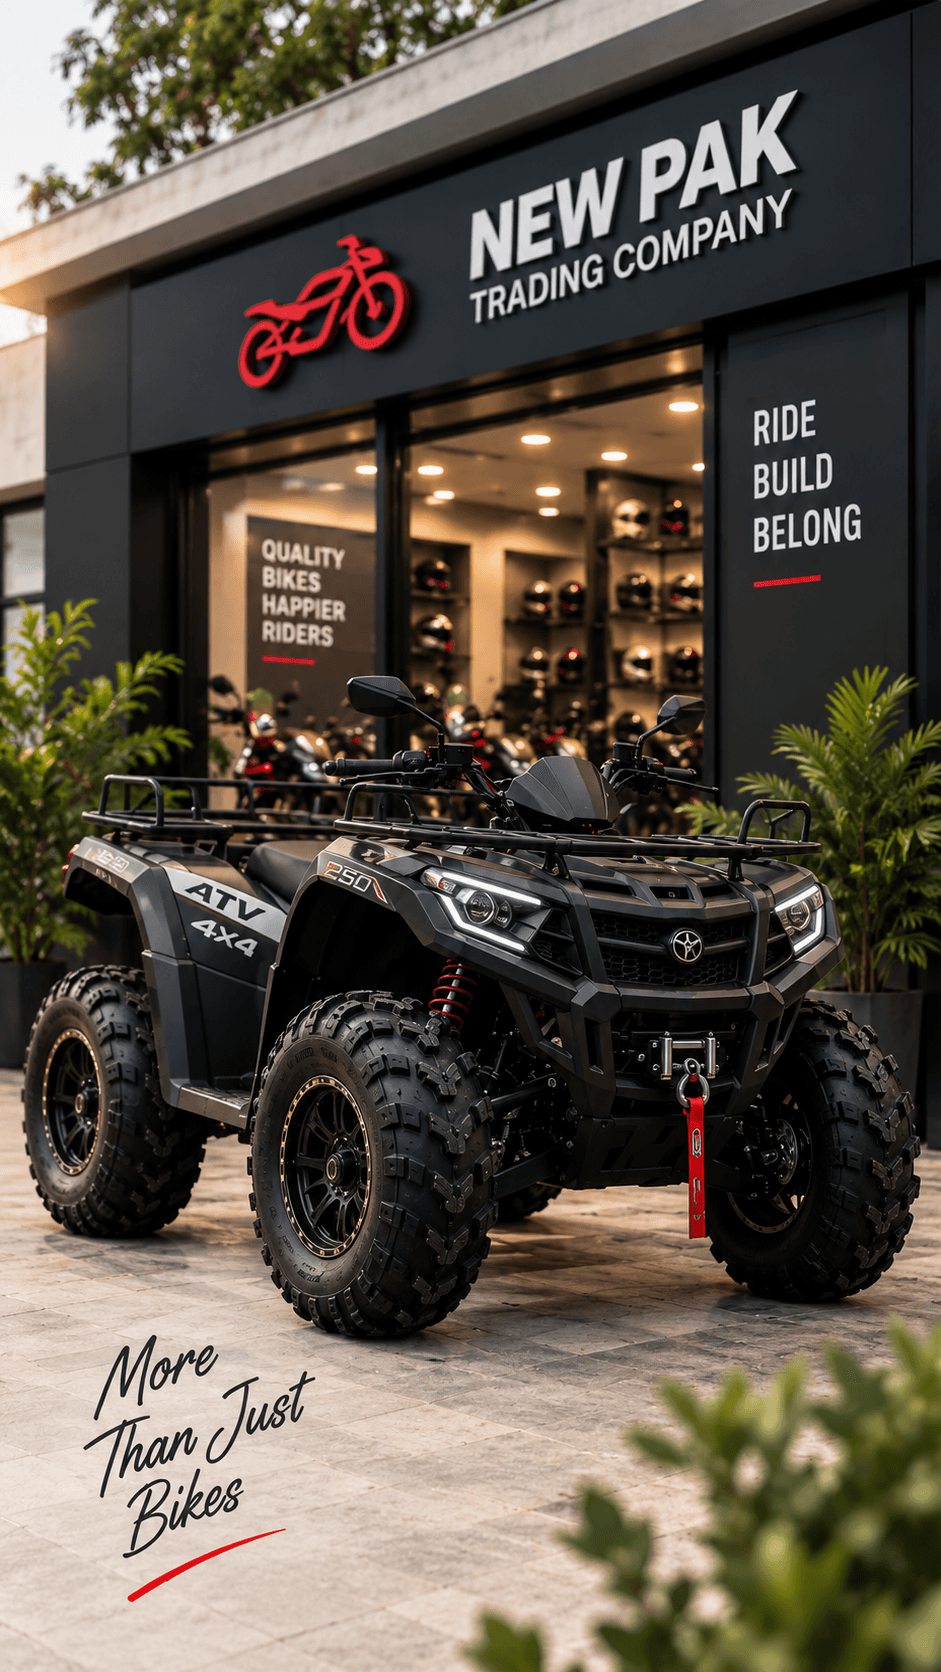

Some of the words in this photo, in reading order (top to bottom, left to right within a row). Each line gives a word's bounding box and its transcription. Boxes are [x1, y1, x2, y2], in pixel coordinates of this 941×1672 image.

[470, 157, 625, 280] NEW
[640, 89, 798, 223] PAK
[470, 254, 604, 324] TRADING
[613, 188, 793, 279] COMPANY
[754, 399, 816, 446] RIDE
[754, 452, 833, 499] BUILD
[754, 503, 862, 553] BELONG
[262, 538, 346, 570] QUALITY
[262, 565, 321, 593] BIKES
[262, 593, 346, 622] HAPPIER
[262, 620, 334, 647] RIDERS
[322, 861, 373, 892] 250
[185, 882, 266, 921] ATV
